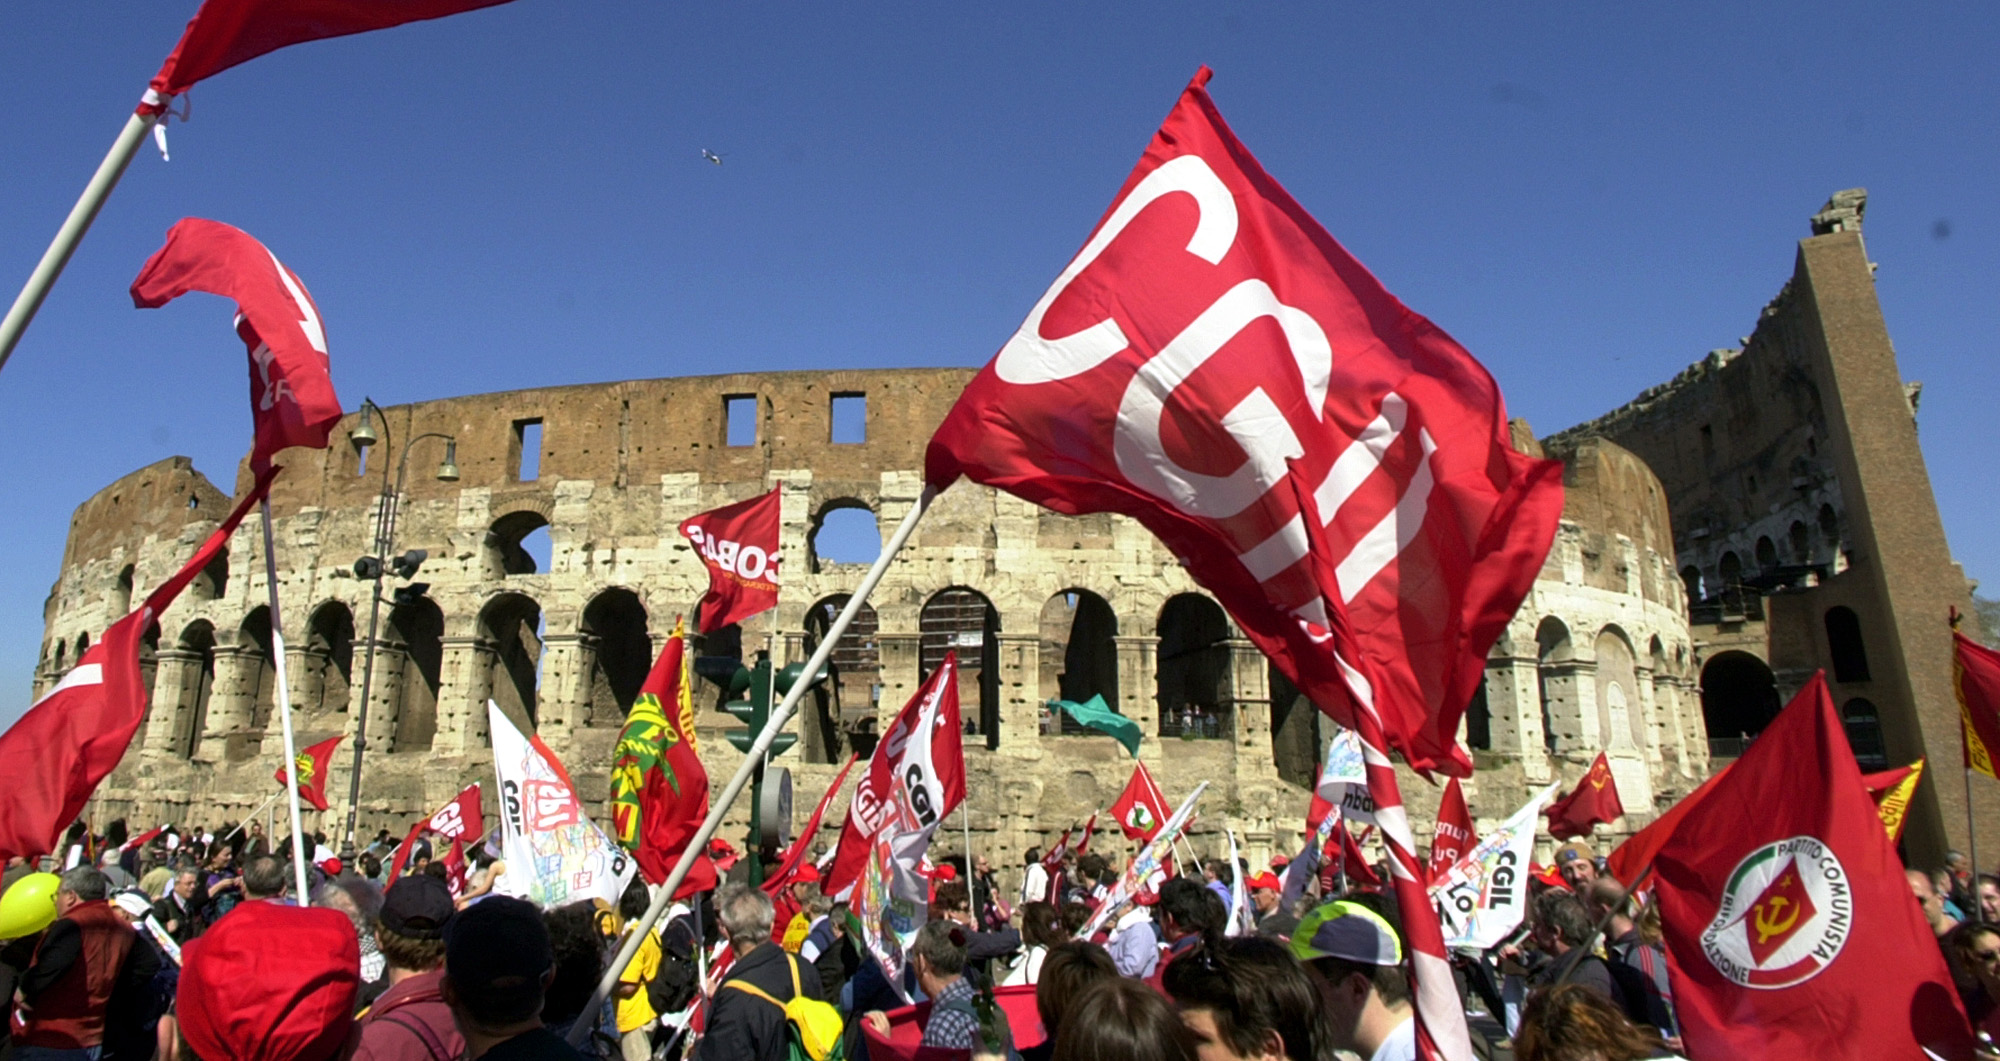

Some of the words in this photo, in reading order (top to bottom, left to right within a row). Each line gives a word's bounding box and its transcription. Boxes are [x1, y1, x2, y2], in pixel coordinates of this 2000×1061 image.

[994, 154, 1438, 642] CGIL
[905, 763, 937, 827] CGI
[1489, 850, 1517, 910] CGIL
[1777, 838, 1822, 860] PARTITO
[1812, 857, 1849, 961] COMUNISTA
[1703, 896, 1748, 983] RIFONDAZIONE
